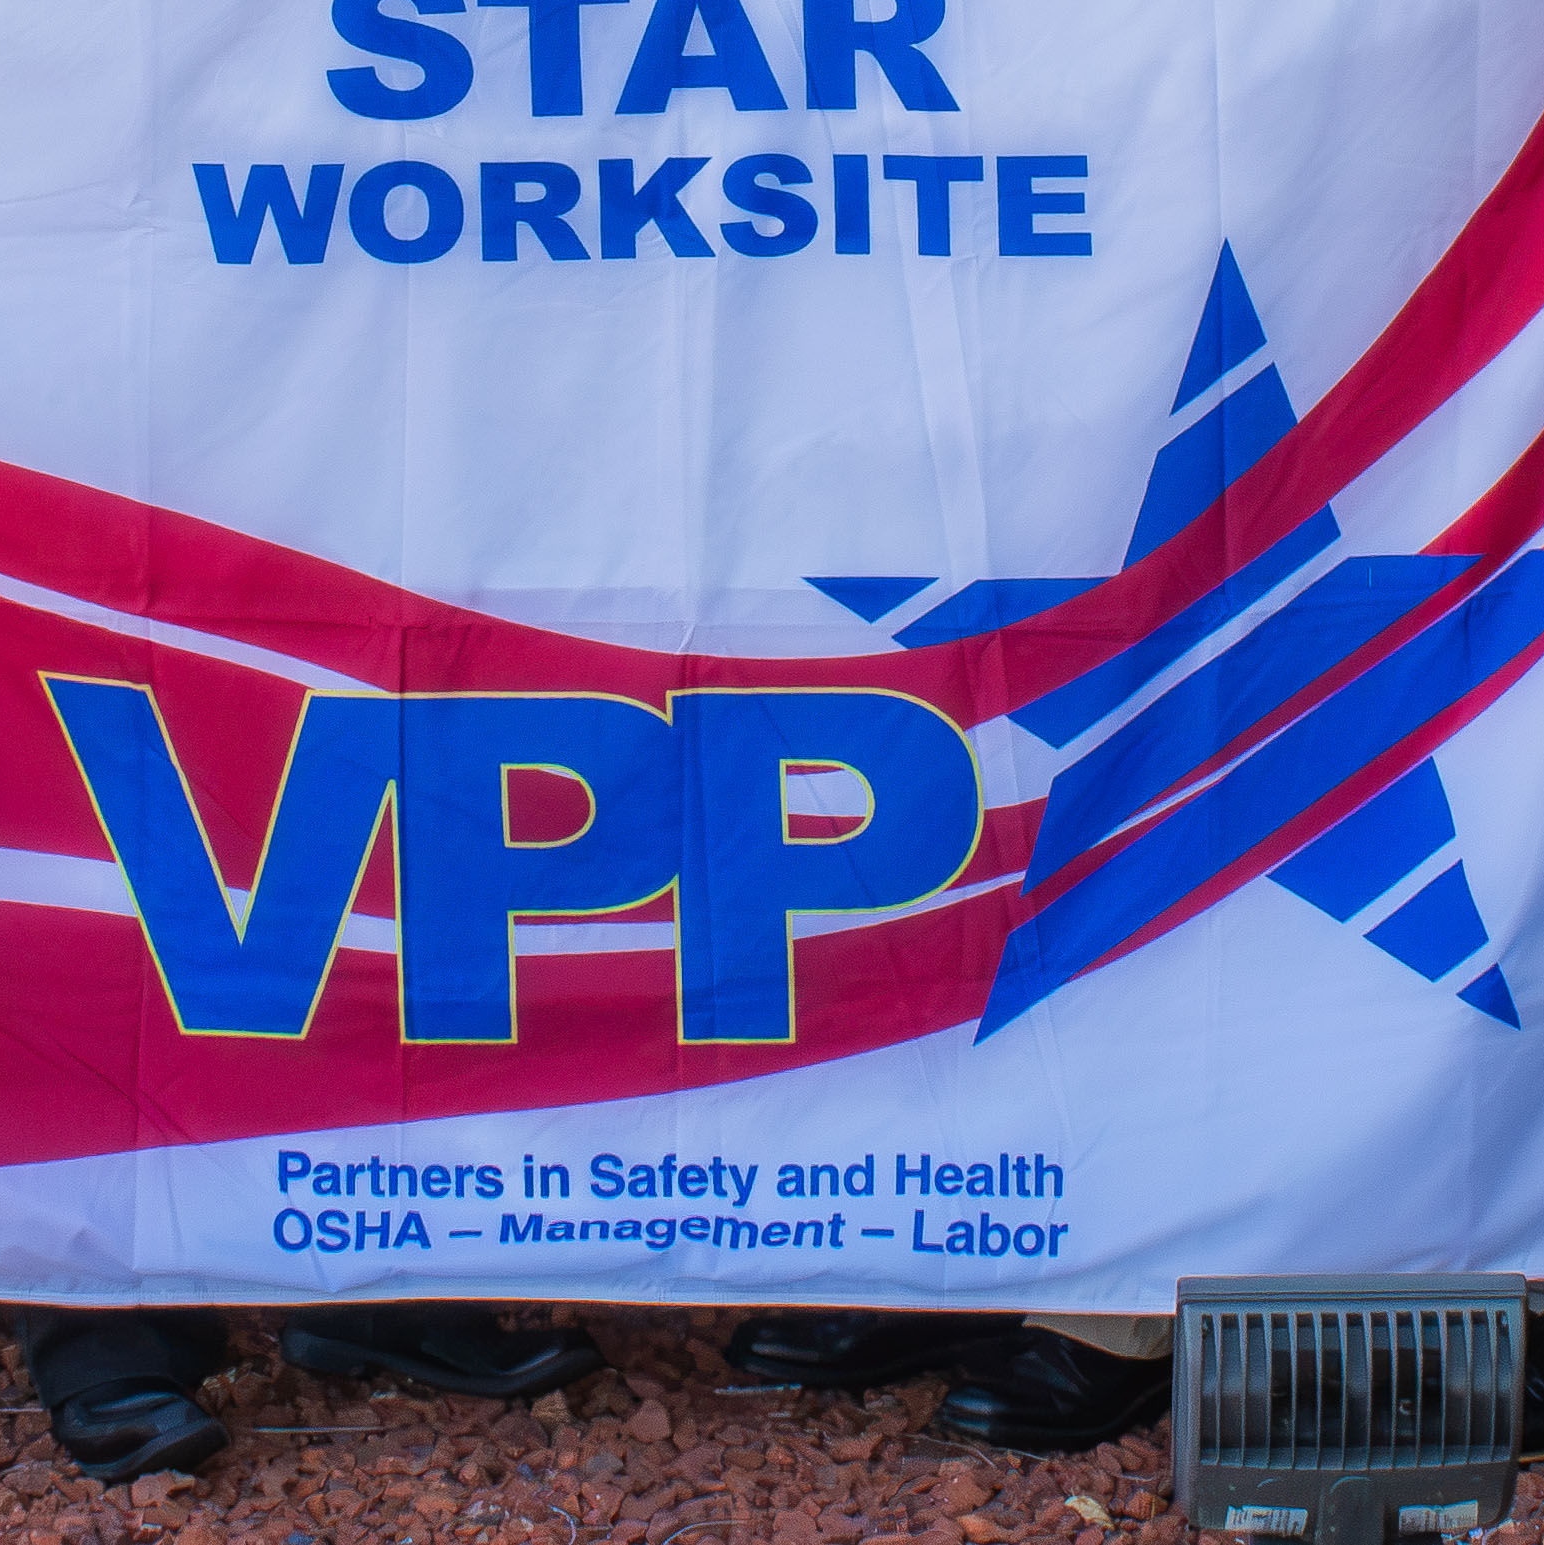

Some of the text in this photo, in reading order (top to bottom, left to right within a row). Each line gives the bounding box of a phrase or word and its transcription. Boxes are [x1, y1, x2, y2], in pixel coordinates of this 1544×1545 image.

[192, 153, 1093, 266] WORKSITE
[37, 671, 985, 1045] VPP
[277, 1149, 1064, 1206] Partners in Safety and Health
[273, 1209, 433, 1252] OSHA
[499, 1211, 846, 1252] Management
[913, 1210, 1069, 1256] Labor
